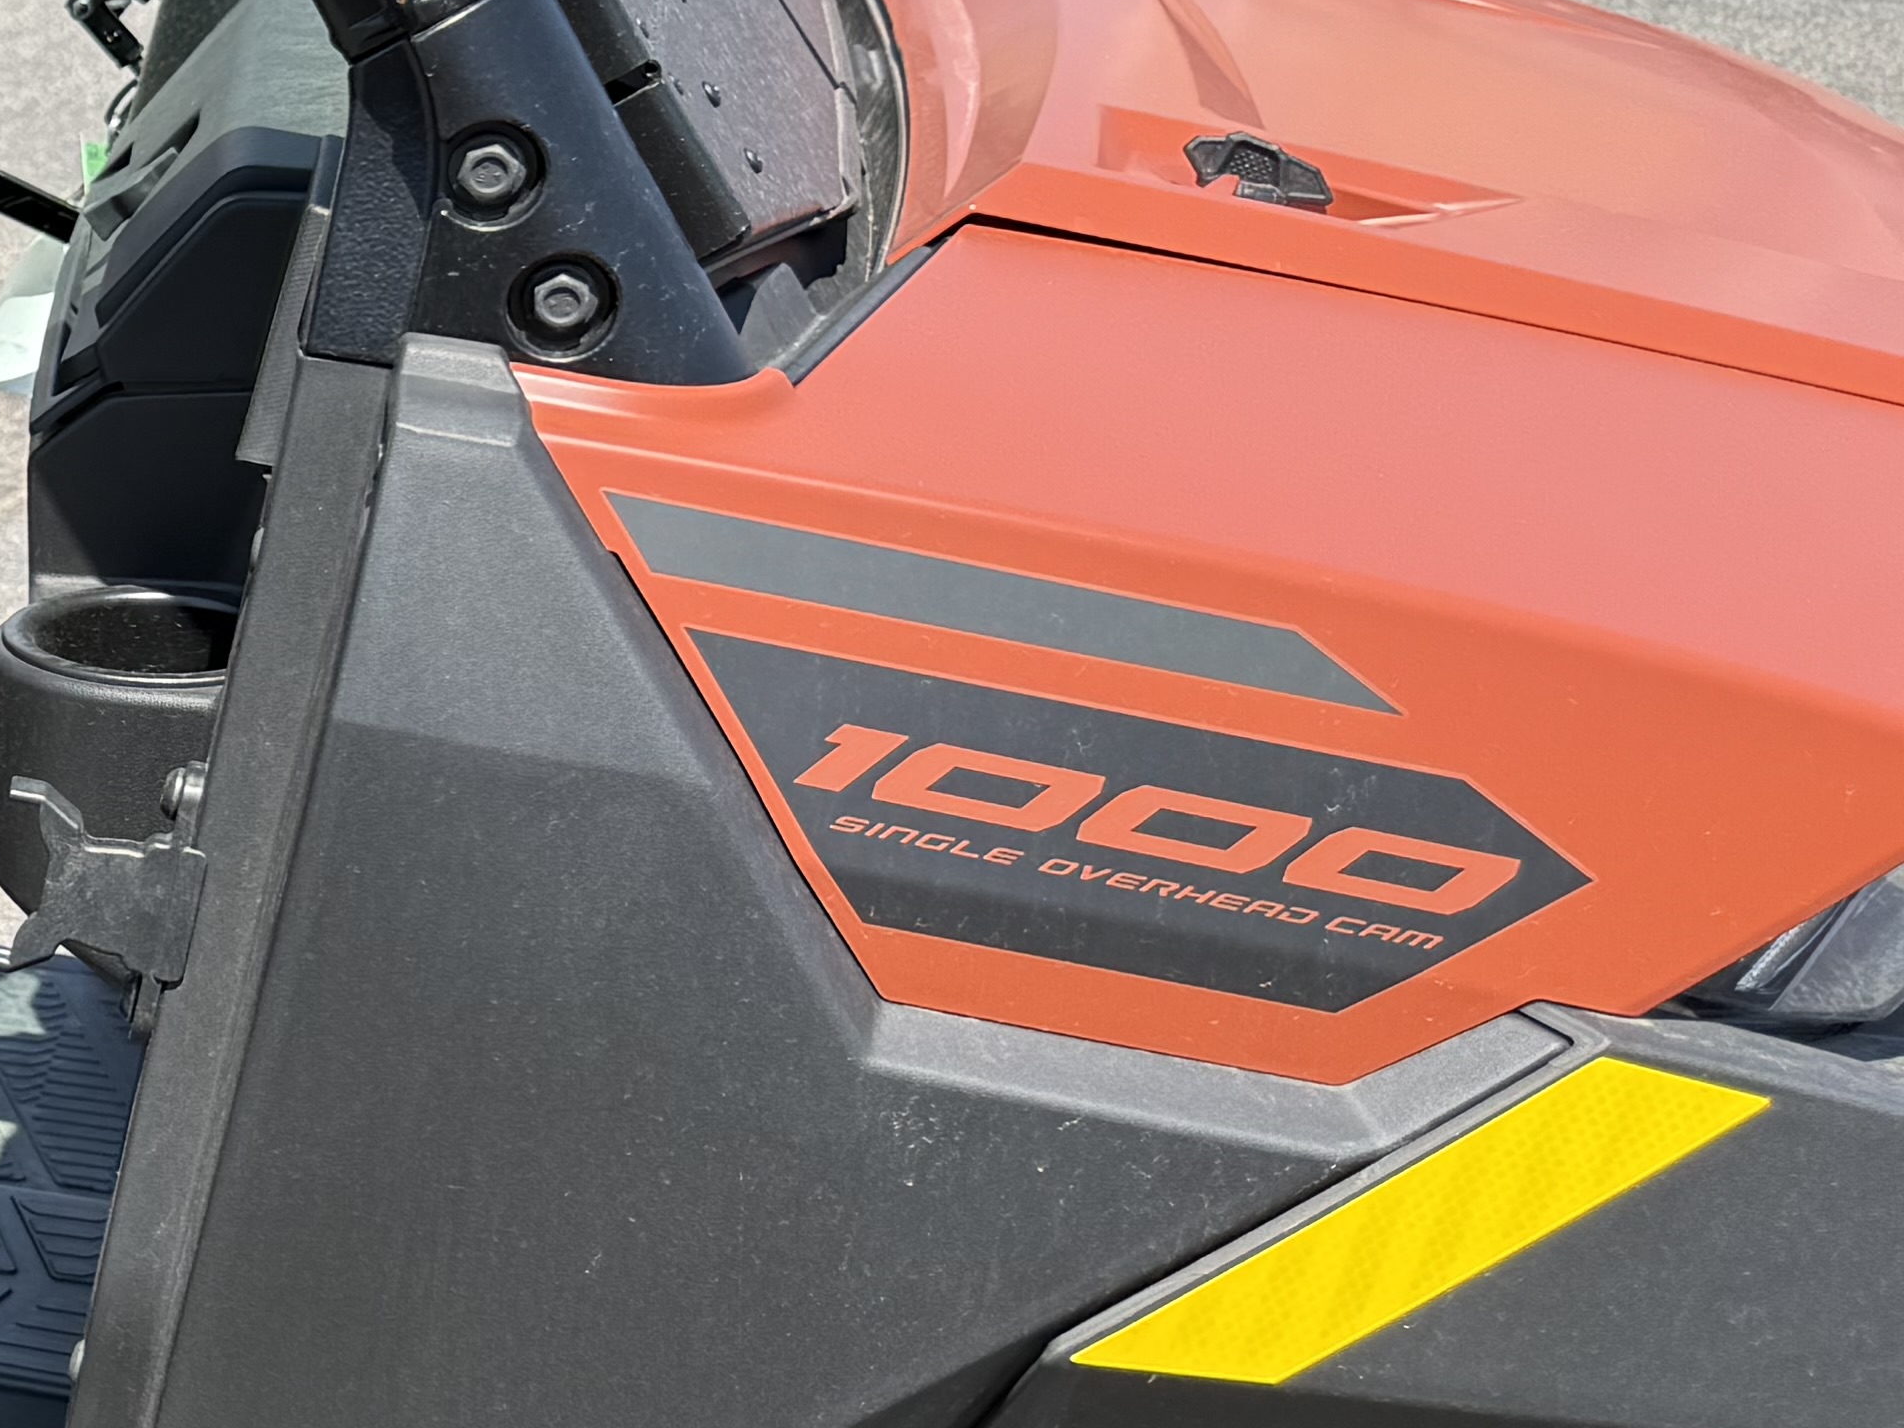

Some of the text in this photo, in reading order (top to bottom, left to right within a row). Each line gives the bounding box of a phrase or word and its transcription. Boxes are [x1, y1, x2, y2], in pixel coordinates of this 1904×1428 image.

[792, 723, 1522, 915] 1000
[829, 815, 1444, 951] SINGLE OVERHEAD CAM
